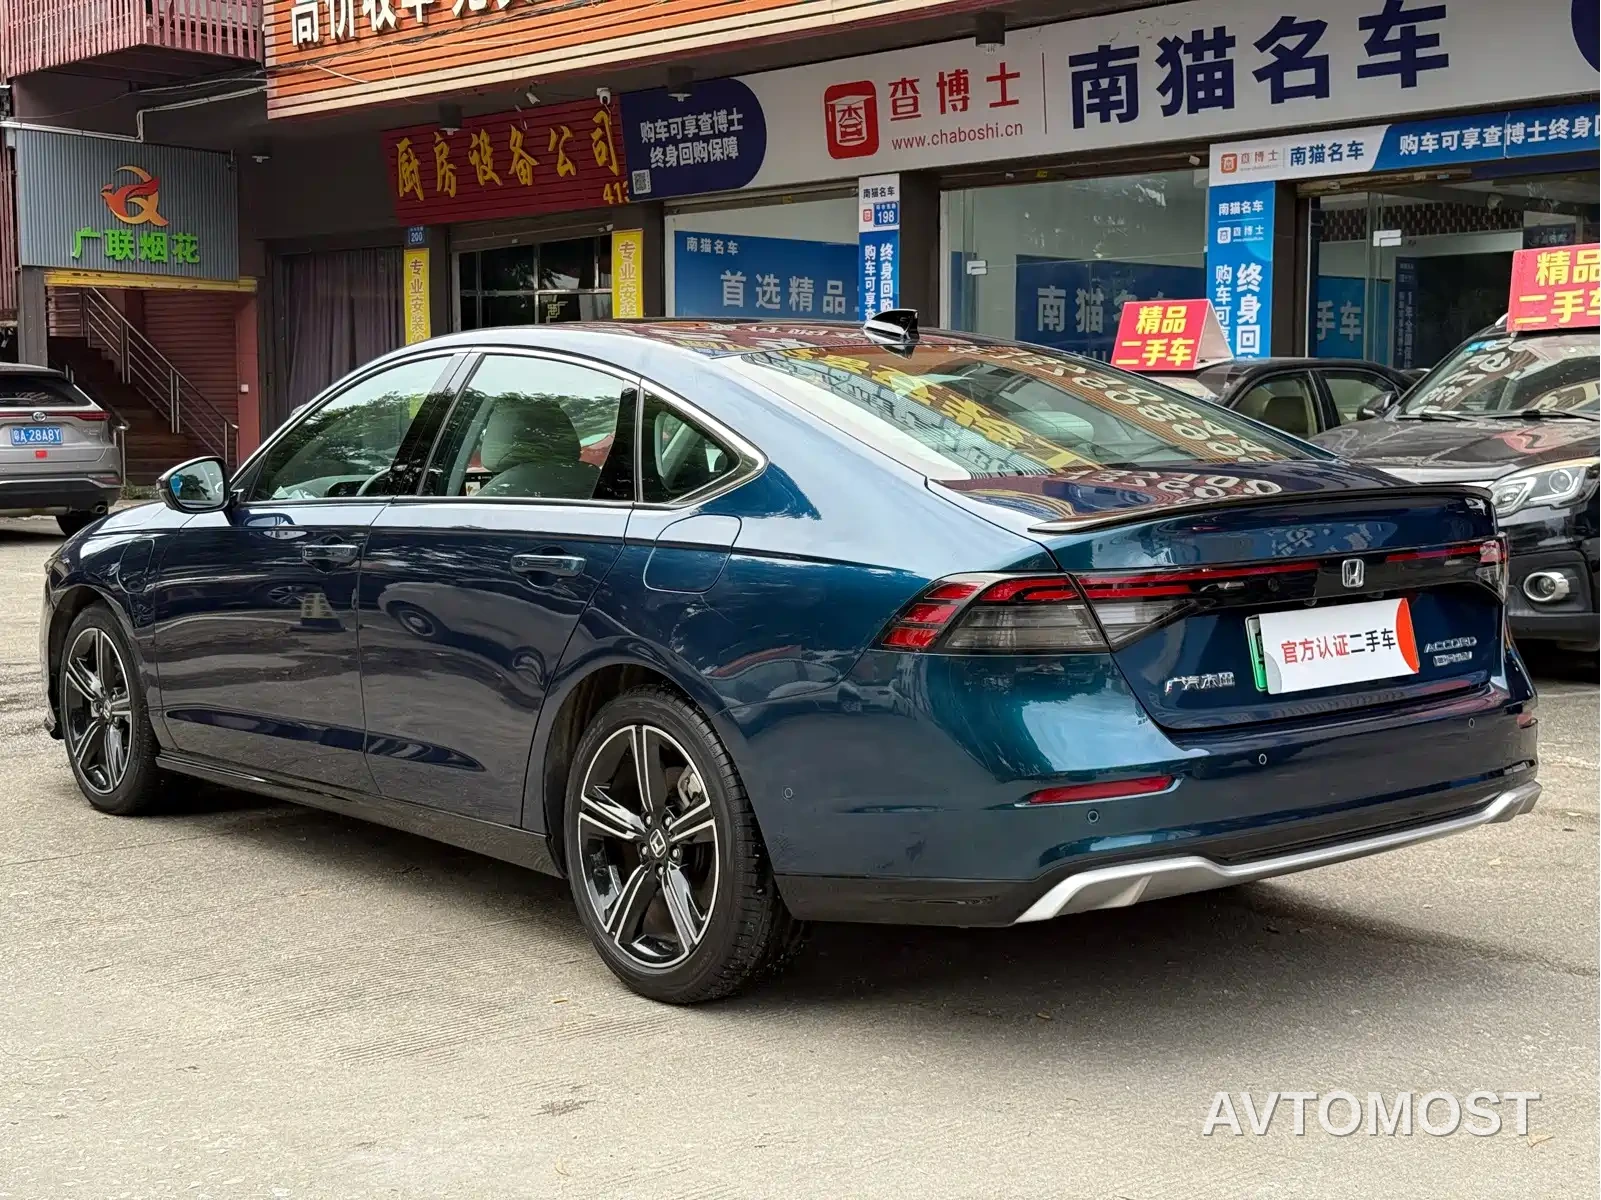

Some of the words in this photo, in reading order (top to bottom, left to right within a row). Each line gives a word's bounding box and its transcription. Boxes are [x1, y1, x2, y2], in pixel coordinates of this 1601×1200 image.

[1068, 0, 1449, 129] 南猫名车
[888, 62, 1021, 121] 查博士
[640, 107, 743, 143] 购车可享查博士
[891, 122, 1024, 150] www.chaboshi.cn
[395, 108, 620, 201] 厨房设备公司
[650, 136, 739, 168] 终身回购保障
[1290, 140, 1364, 166] 南猫名车
[863, 186, 895, 198] 南猫名车
[878, 210, 895, 224] 198
[1218, 200, 1264, 216] 南猫名车
[72, 227, 200, 264] 广联烟花
[411, 231, 423, 242] 200
[687, 236, 738, 256] 南猫名车
[1535, 248, 1600, 287] 精品
[720, 269, 846, 315] 首选精品
[1136, 305, 1187, 335] 精品
[1236, 262, 1263, 360] 终身回
[1115, 337, 1194, 367] 二手车
[1281, 627, 1397, 665] 官方认证二手车
[1424, 636, 1477, 653] ACCORD
[1164, 671, 1235, 696] 广汽本田
